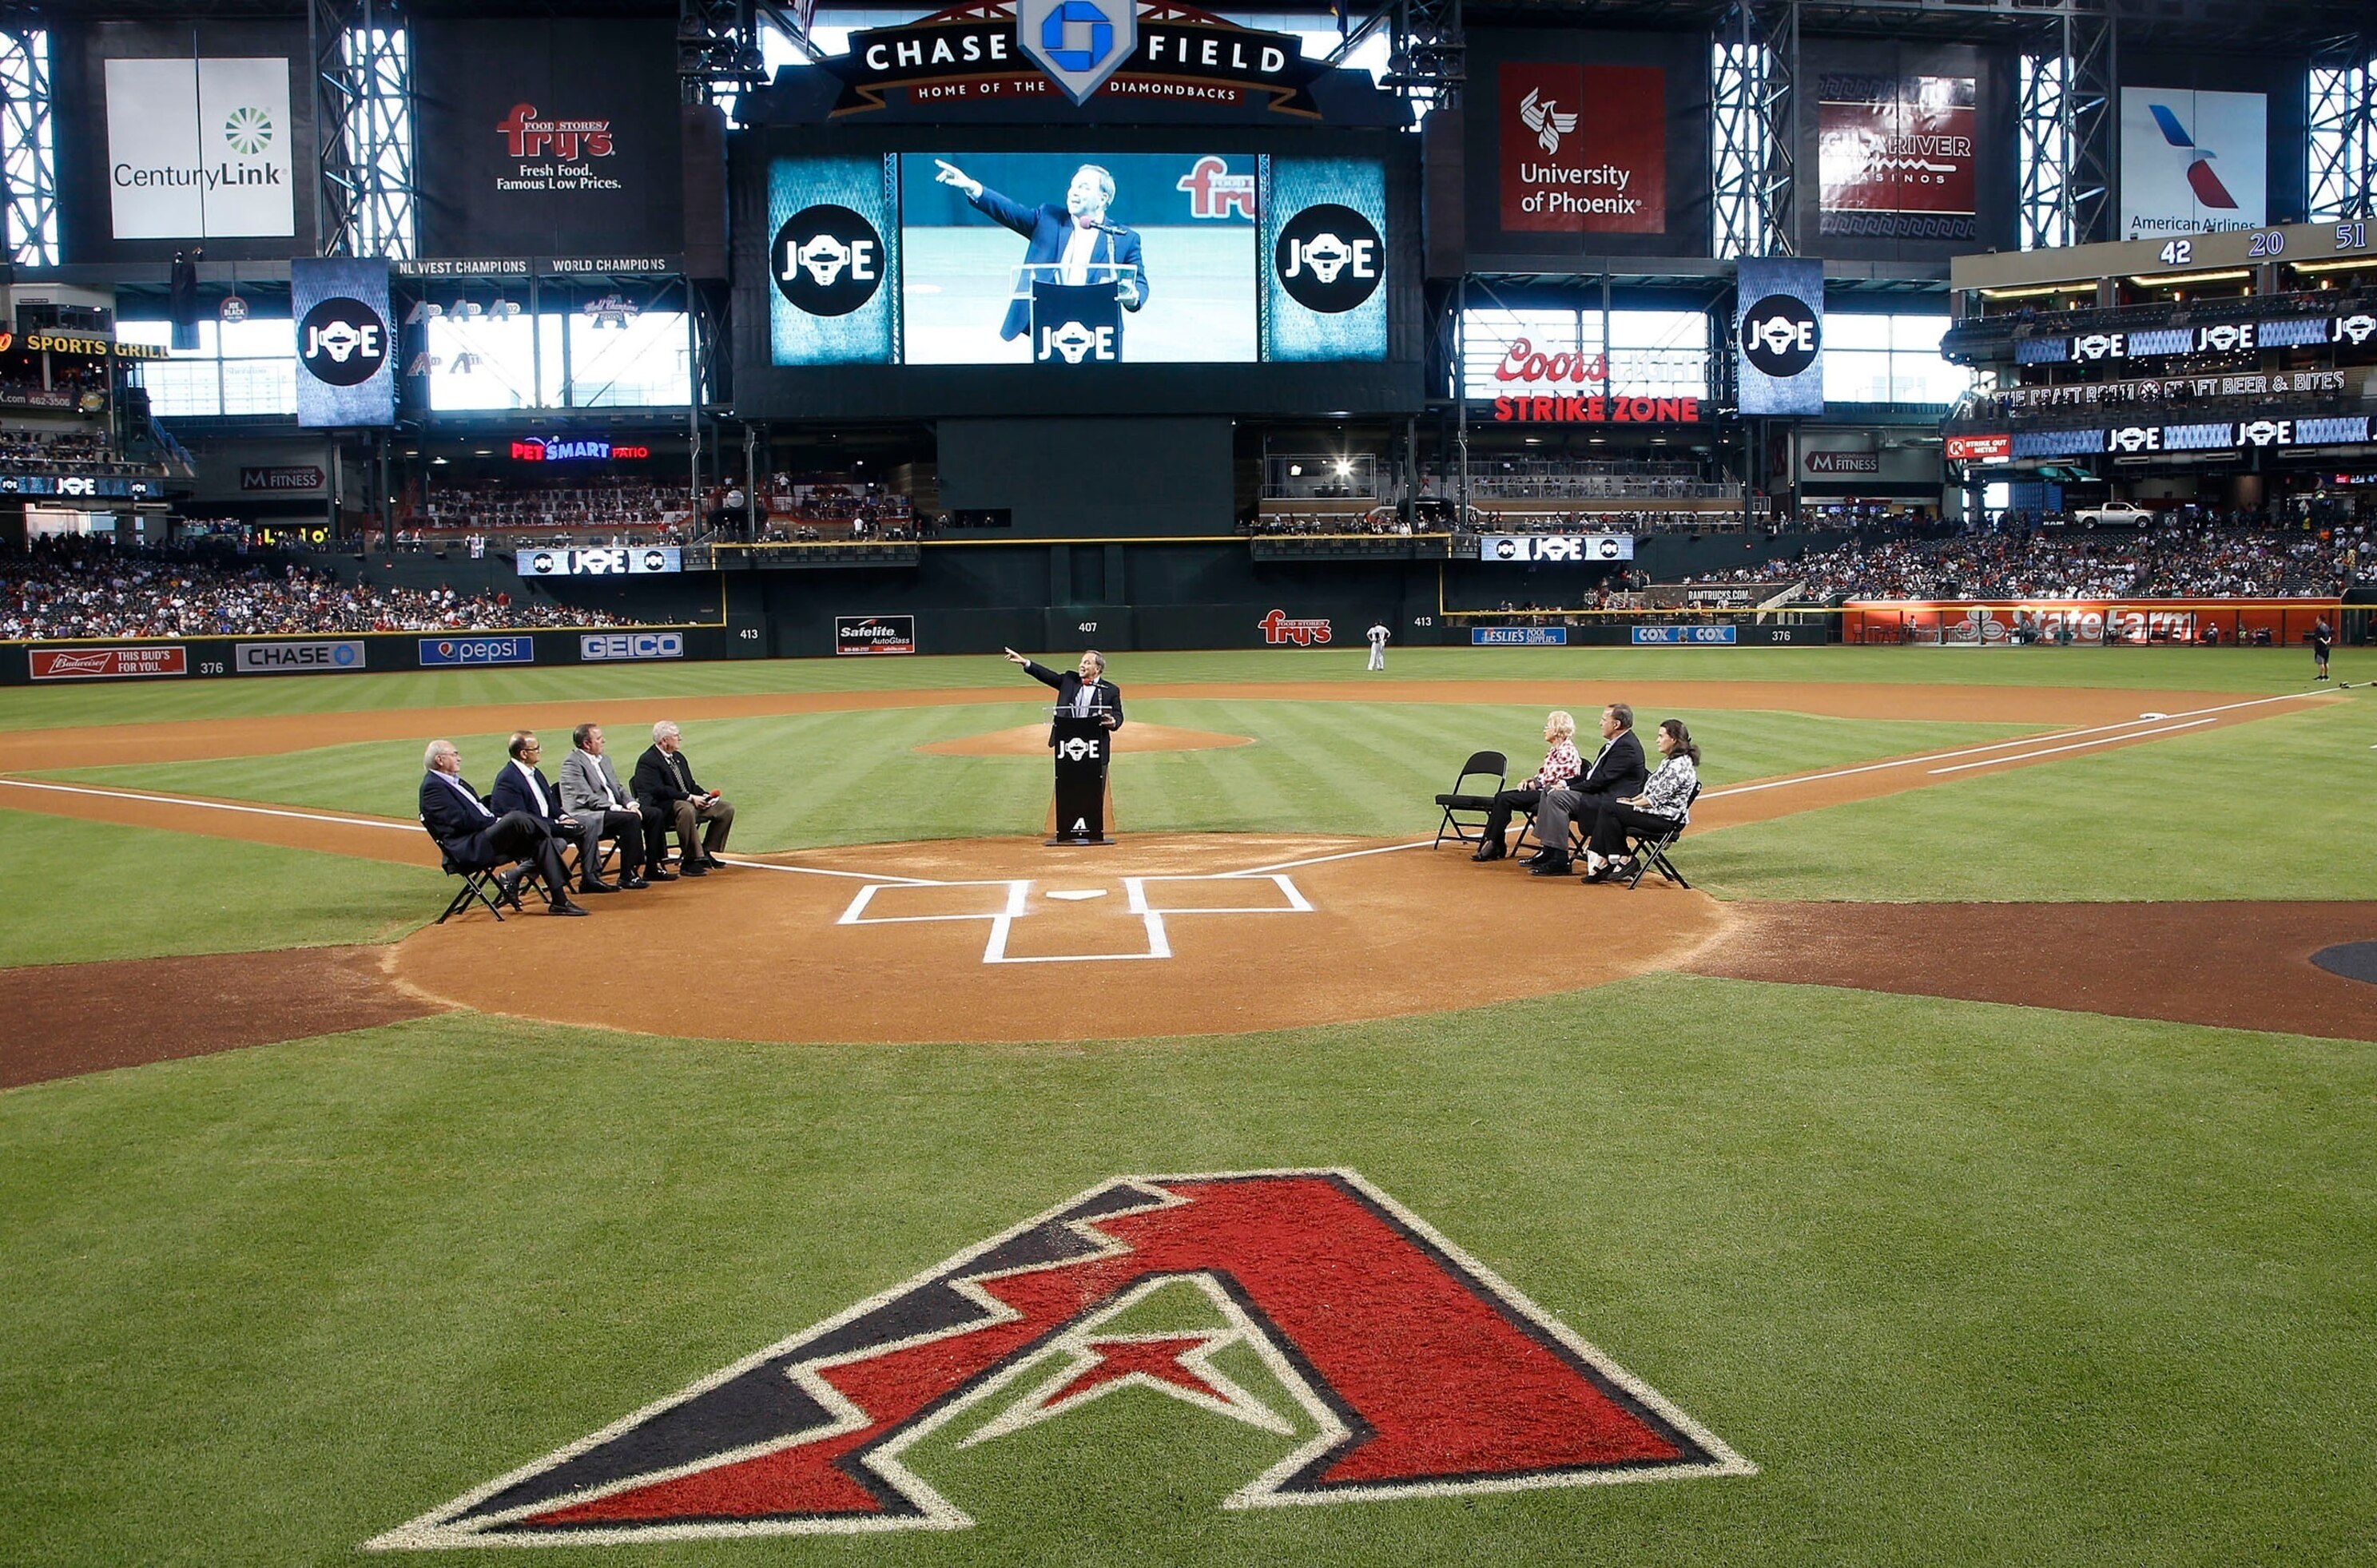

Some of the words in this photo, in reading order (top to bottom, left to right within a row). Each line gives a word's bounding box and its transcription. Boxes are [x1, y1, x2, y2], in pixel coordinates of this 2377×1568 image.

[865, 34, 1008, 71] CHASE
[1149, 35, 1286, 73] FIELD
[918, 85, 968, 98] HOME
[980, 82, 1001, 94] OF
[1014, 81, 1045, 93] THE
[1111, 81, 1237, 101] DIAMONDBACKS
[496, 102, 613, 162] fry's
[524, 121, 555, 130] FOOD
[559, 121, 603, 130] STORES
[1889, 134, 1970, 157] RIVER
[113, 162, 281, 191] CenturyLink
[520, 164, 554, 177] Fresh
[558, 164, 593, 177] Food.
[1520, 164, 1630, 191] University
[496, 177, 545, 190] Famous
[549, 178, 576, 190] Low
[580, 177, 622, 189] Prices.
[1847, 173, 1946, 185] ASINOS
[1521, 194, 1543, 213] of
[2132, 216, 2200, 232] American
[2202, 219, 2256, 233] Airlines
[2335, 223, 2367, 249] 51
[2248, 231, 2284, 257] 20
[2160, 240, 2192, 265] 42
[399, 262, 415, 275] NL
[418, 261, 452, 275] WEST
[455, 260, 527, 273] CHAMPIONS
[553, 260, 592, 272] WORLD
[595, 258, 666, 272] CHAMPIONS
[2332, 315, 2377, 342] JO
[27, 335, 107, 355] SPORTS
[114, 342, 170, 359] GRILL
[1494, 338, 1609, 383] Coors
[1613, 354, 1711, 383] LIGHT
[2164, 379, 2217, 399] CRFT
[2223, 375, 2267, 395] BEER
[2272, 375, 2288, 393] &
[2294, 371, 2345, 391] BITES
[1494, 395, 1605, 422] STRIKE
[1612, 395, 1699, 422] ZONE
[511, 441, 609, 461] PETSMART
[612, 447, 649, 458] PATIO
[1836, 459, 1877, 470] FITNESS
[271, 474, 317, 486] FITNESS
[1687, 589, 1749, 601] RAMTRUCKS.COM
[1078, 623, 1098, 633] 407
[1258, 609, 1332, 647] fry's
[1414, 617, 1433, 627] 413
[740, 629, 758, 640] 413
[841, 626, 895, 637] Safelite
[1482, 629, 1524, 642] LESLIE'S
[1526, 634, 1556, 644] SUPPLIES
[1639, 628, 1668, 641] COX
[1695, 628, 1727, 641] COX
[1771, 630, 1791, 641] 376
[460, 639, 518, 662] pepsi
[582, 634, 682, 657] GEICO
[54, 657, 105, 669] Budweiser
[117, 651, 139, 661] THIS
[141, 650, 170, 661] BUD'S
[248, 645, 330, 666] CHASE
[118, 662, 137, 673] FOR
[140, 661, 161, 672] YOU.
[201, 662, 224, 674] 376
